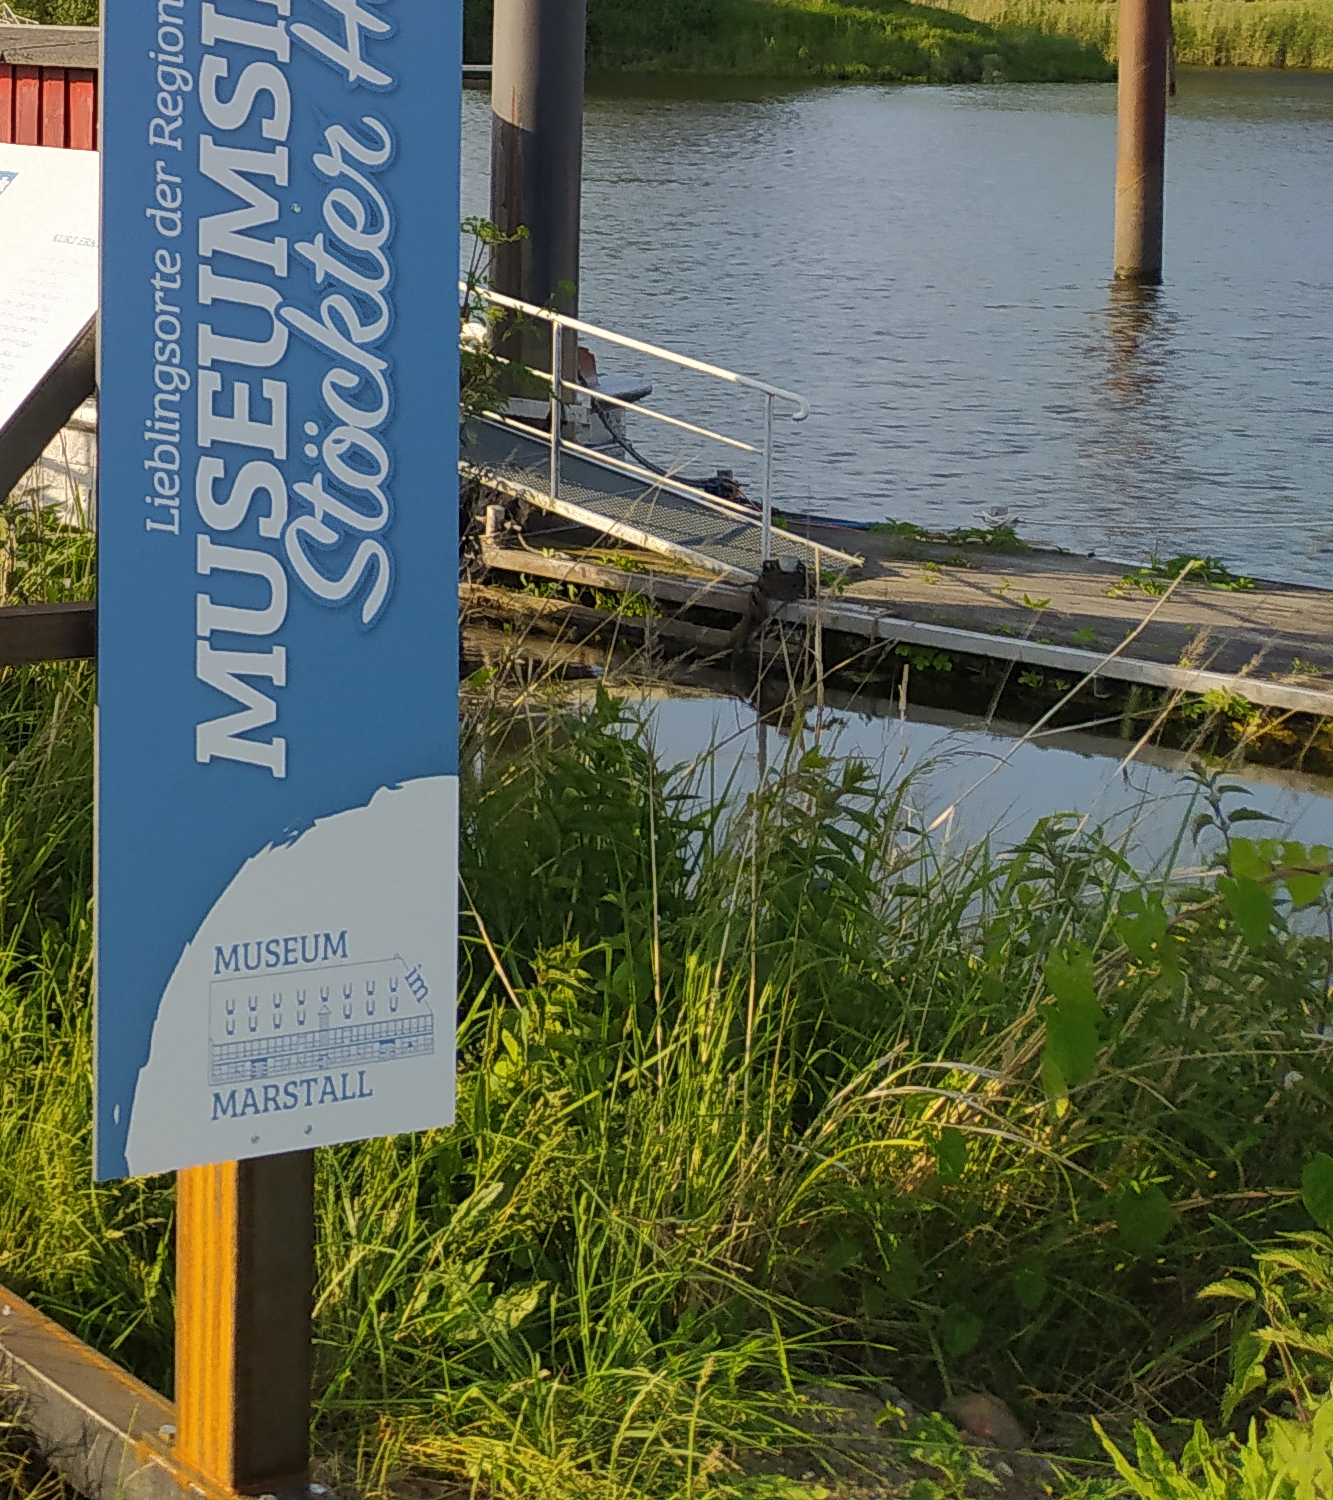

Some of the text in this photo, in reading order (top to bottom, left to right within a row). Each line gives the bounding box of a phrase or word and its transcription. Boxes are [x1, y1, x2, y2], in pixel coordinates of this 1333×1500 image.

[146, 160, 183, 239] der
[144, 246, 191, 536] Lieblingsorte
[280, 114, 392, 625] Stöckter
[213, 929, 349, 975] MUSEUM
[404, 963, 432, 1004] im
[211, 1069, 374, 1121] MARSTALL
